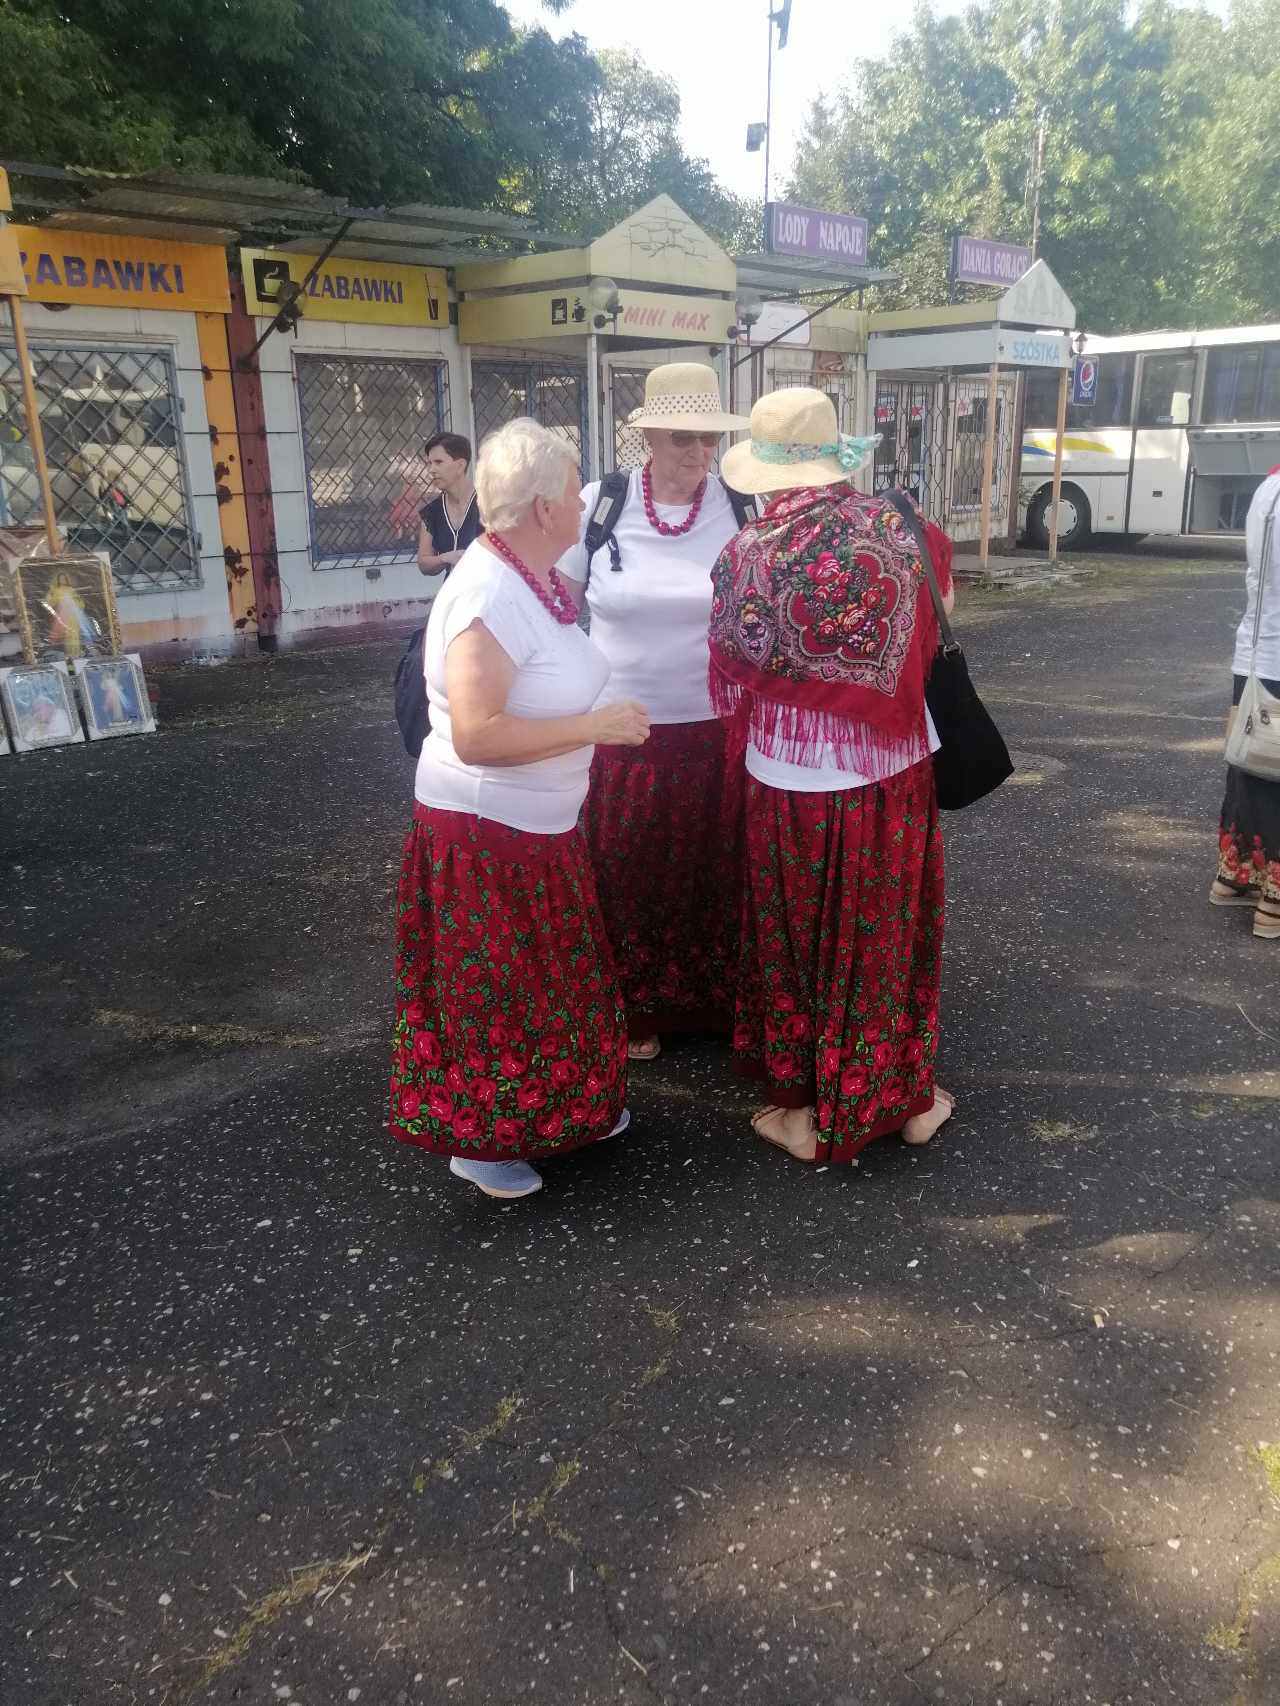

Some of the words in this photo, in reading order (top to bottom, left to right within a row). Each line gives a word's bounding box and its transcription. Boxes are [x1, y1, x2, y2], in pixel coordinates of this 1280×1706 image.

[778, 212, 809, 247] LODY
[819, 220, 863, 256] NAPOJE
[962, 244, 991, 276] DANIA
[308, 263, 404, 305] ZABAWKI
[624, 304, 667, 328] MINI
[671, 310, 711, 332] MAX
